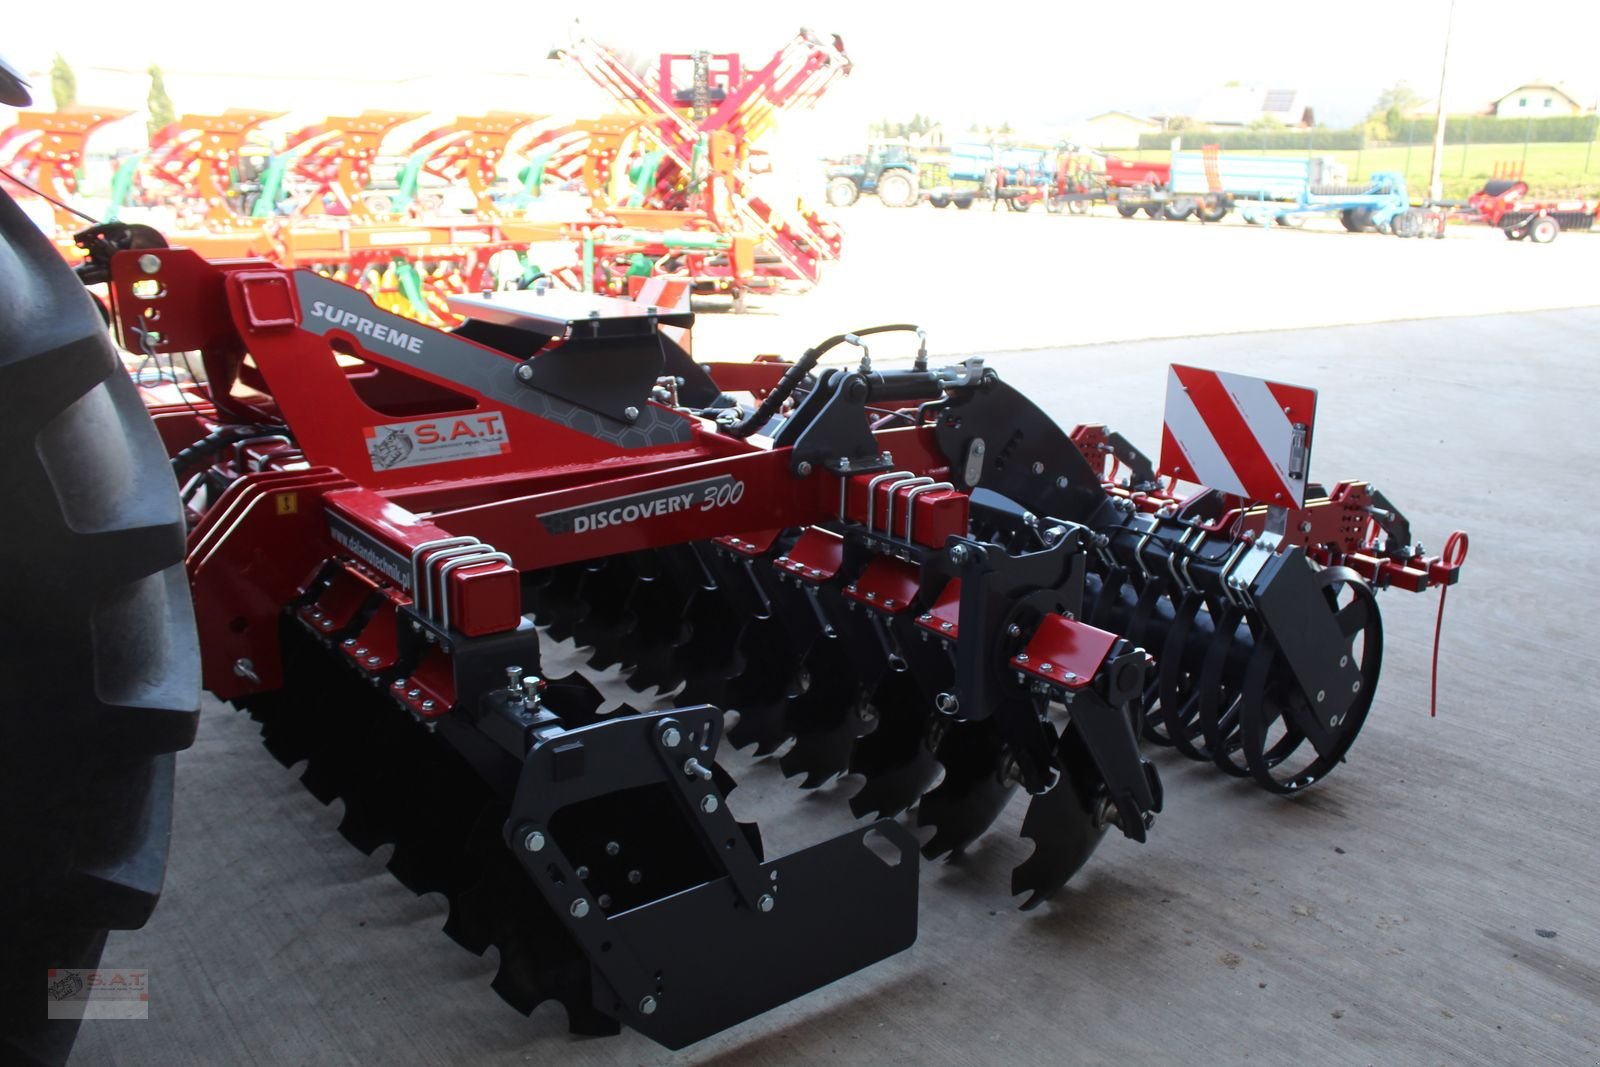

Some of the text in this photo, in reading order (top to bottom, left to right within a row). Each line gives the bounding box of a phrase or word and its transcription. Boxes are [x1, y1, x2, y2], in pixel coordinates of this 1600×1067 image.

[310, 301, 424, 354] SUPREME
[414, 415, 503, 444] S.A.T.
[574, 480, 745, 534] DISCOVERY 300
